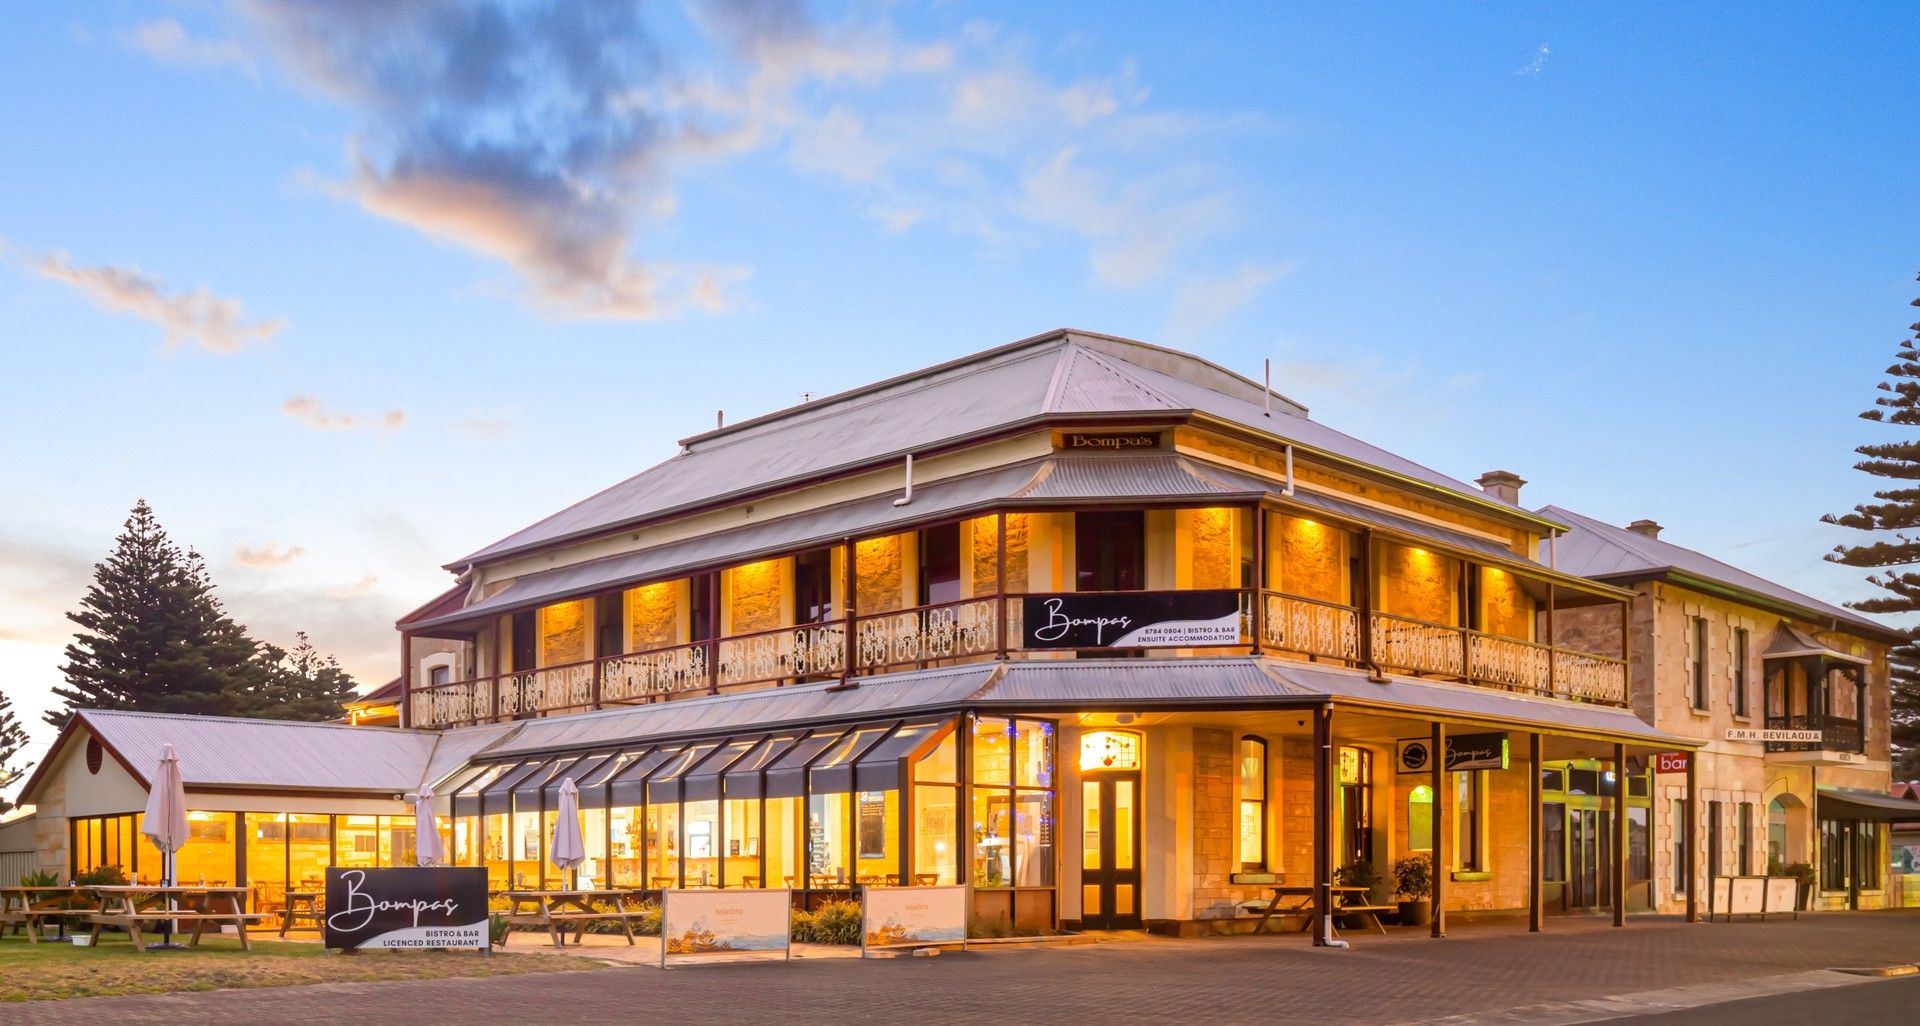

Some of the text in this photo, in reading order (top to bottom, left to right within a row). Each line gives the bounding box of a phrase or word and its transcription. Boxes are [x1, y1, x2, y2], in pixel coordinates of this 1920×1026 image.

[1071, 435, 1153, 449] Bompa's
[1034, 598, 1132, 645] Bompas
[1763, 731, 1820, 740] BEVILAQUA
[1661, 756, 1687, 770] bar
[327, 869, 459, 932] Bompas
